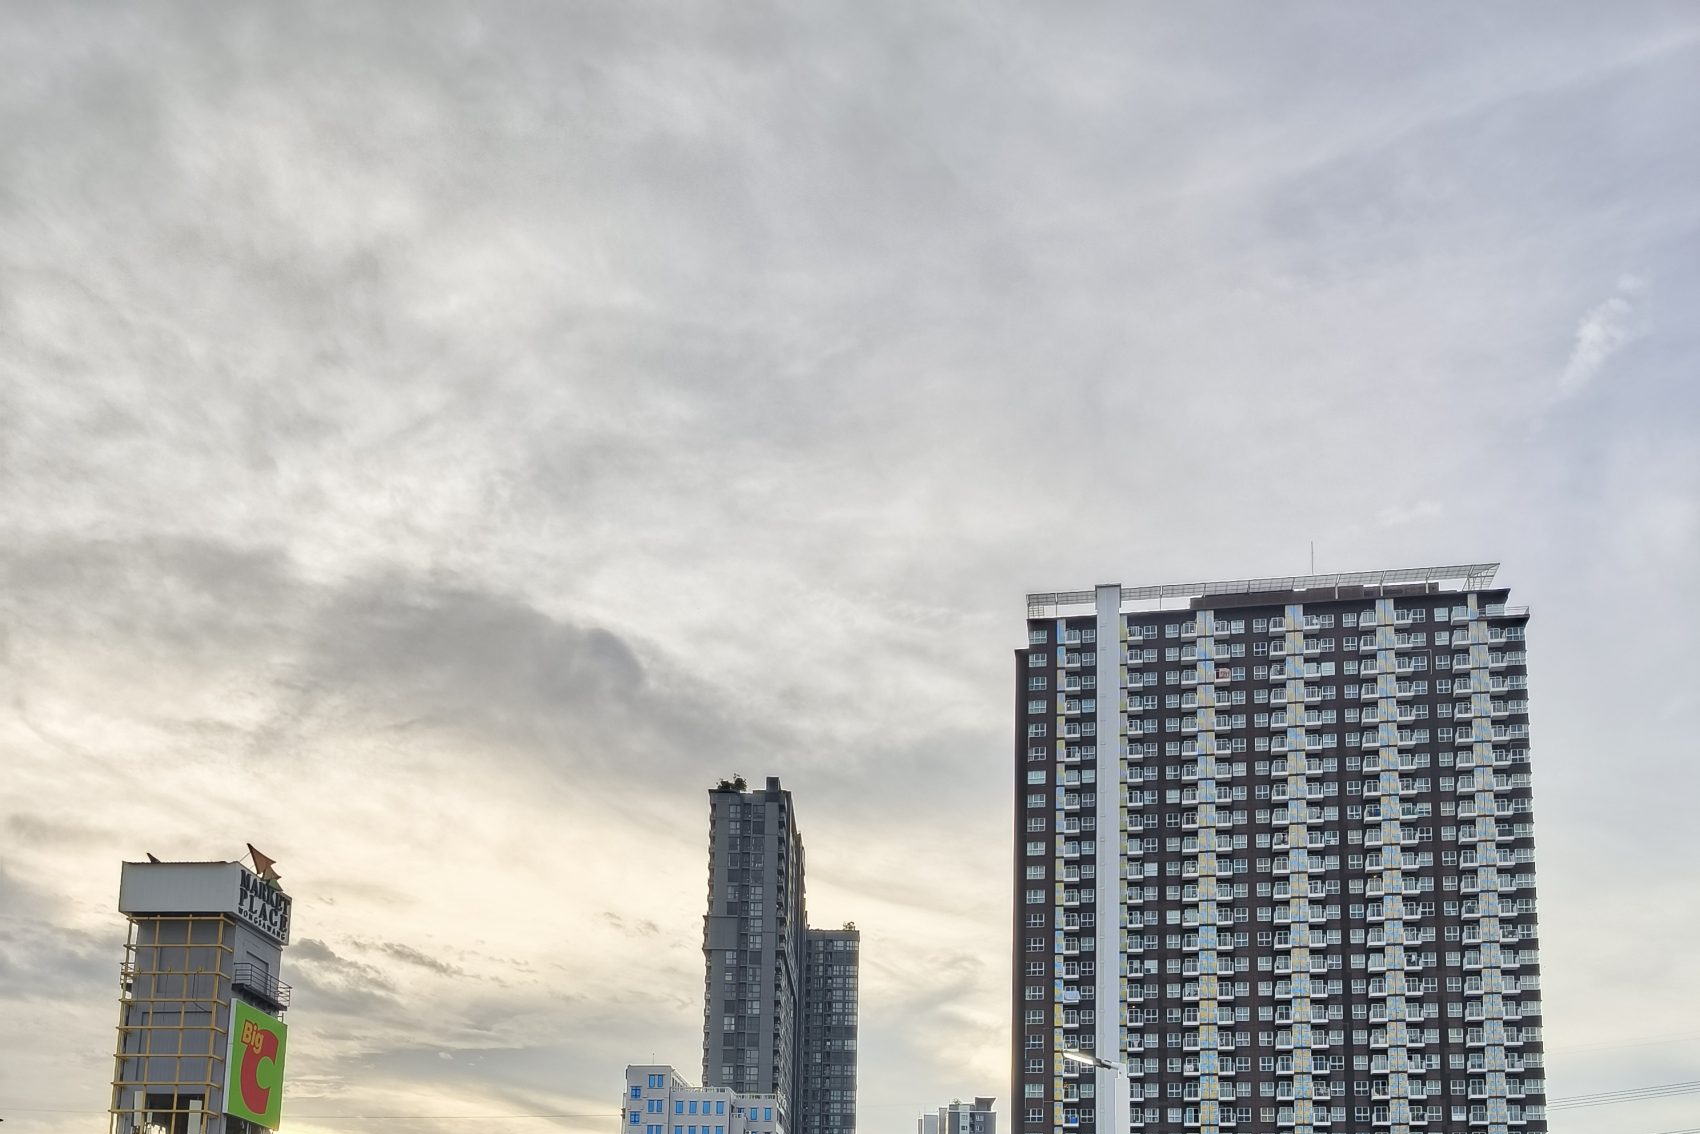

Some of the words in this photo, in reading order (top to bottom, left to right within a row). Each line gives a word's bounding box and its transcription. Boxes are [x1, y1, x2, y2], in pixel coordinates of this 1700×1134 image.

[238, 887, 288, 932] PLACE
[240, 869, 290, 915] MARKET
[238, 906, 286, 940] WONGSAWANG
[241, 1019, 264, 1054] Big
[240, 1029, 279, 1115] C
